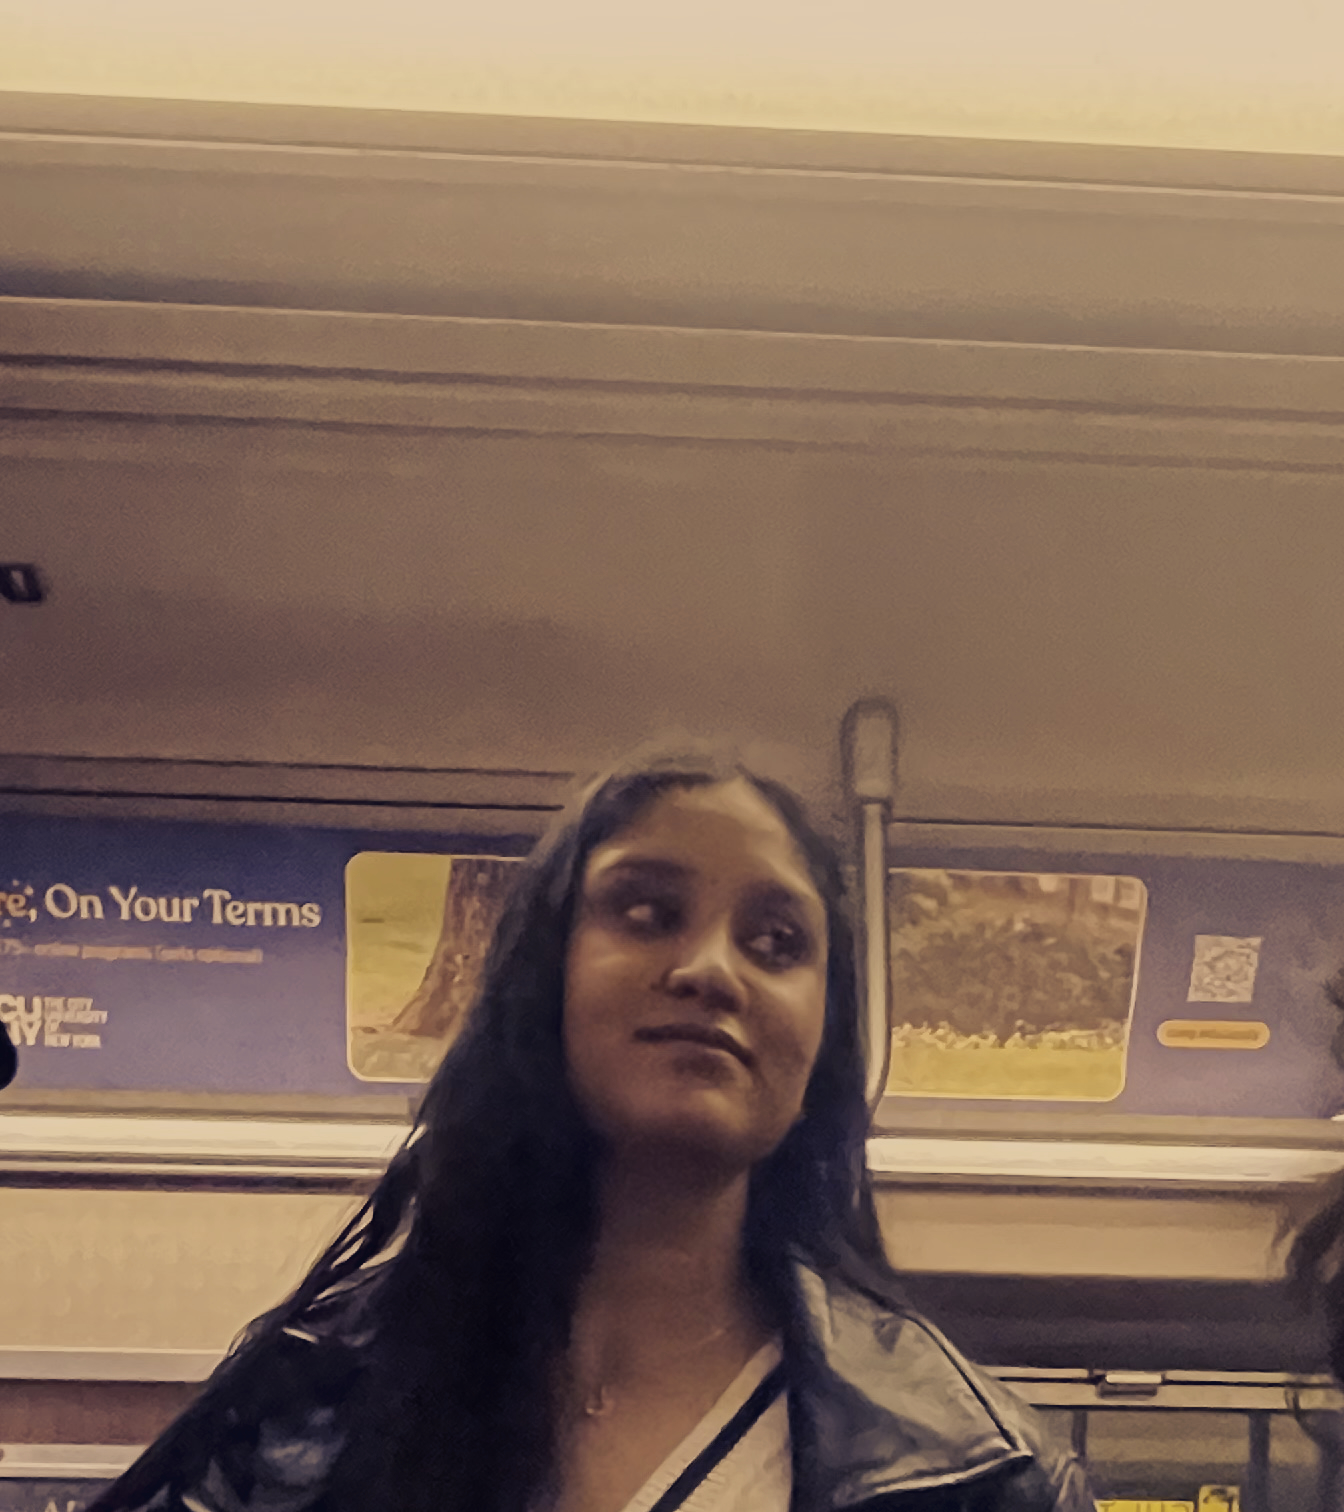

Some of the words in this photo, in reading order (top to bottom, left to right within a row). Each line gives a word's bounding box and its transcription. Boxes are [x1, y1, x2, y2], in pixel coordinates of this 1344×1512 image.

[45, 883, 104, 919] On
[110, 886, 200, 923] Your
[203, 889, 322, 928] Terms
